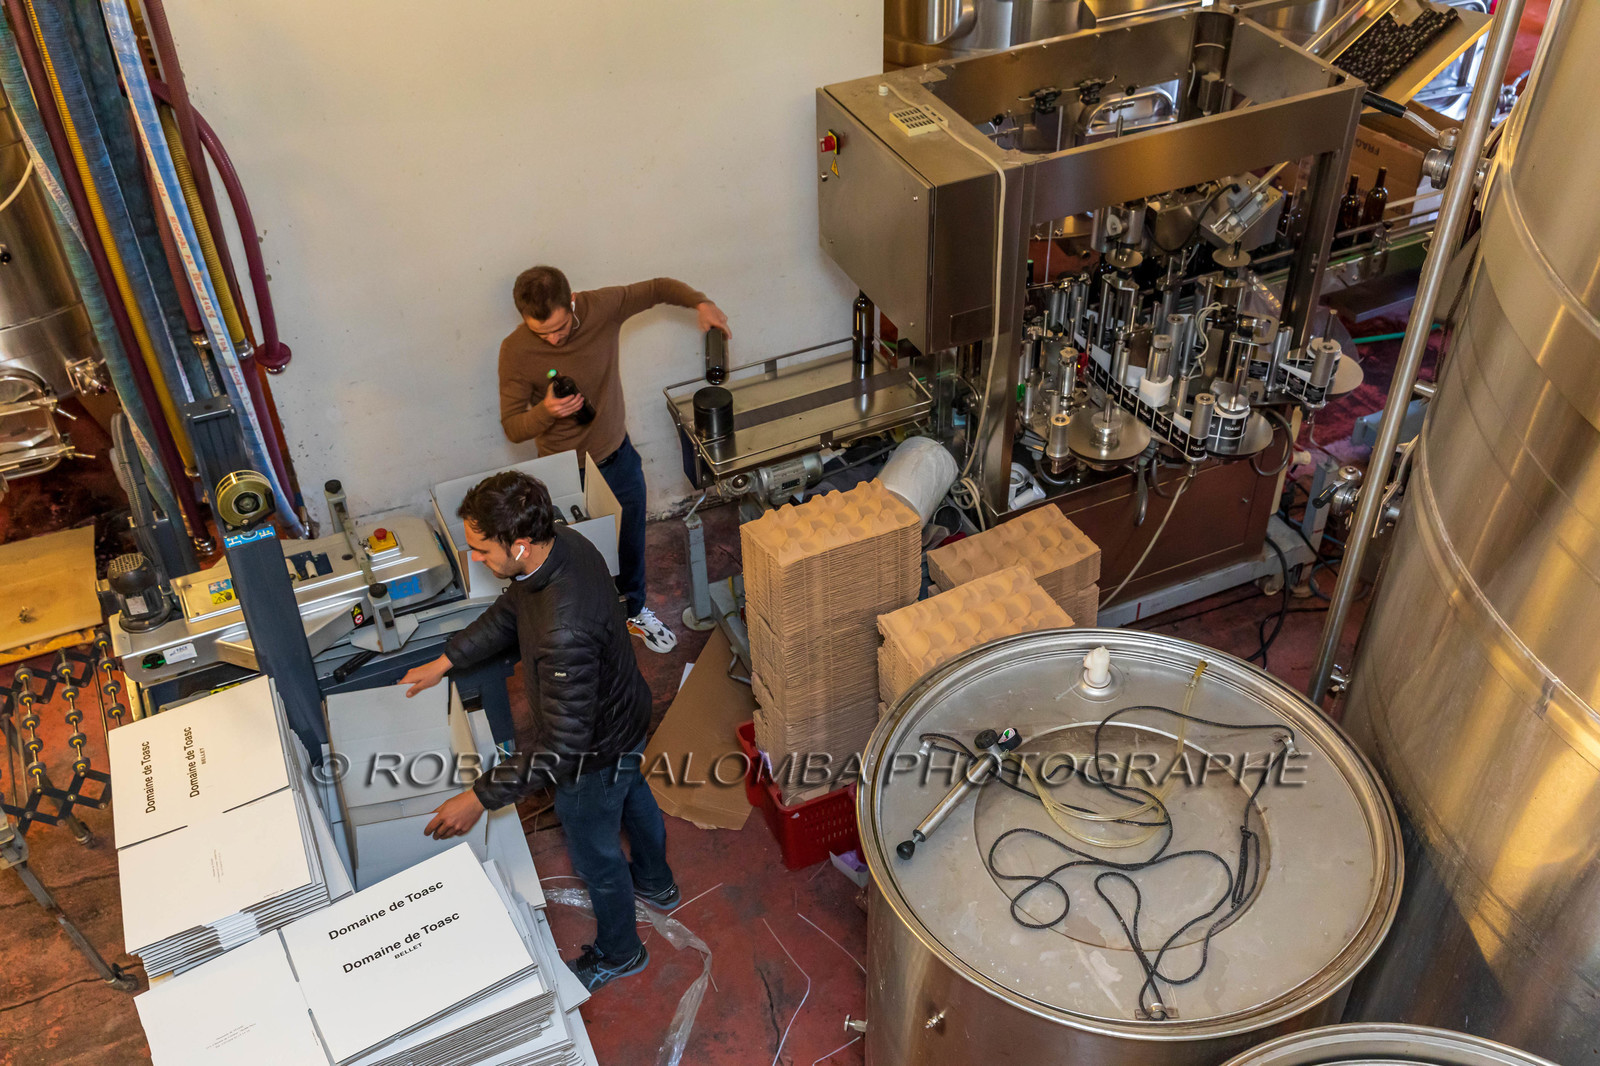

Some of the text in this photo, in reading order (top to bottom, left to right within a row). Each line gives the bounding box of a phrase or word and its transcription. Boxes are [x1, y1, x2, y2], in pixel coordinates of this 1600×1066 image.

[388, 576, 422, 600] iat
[141, 741, 156, 813] Domaine de Toasc
[184, 726, 200, 798] Domaine de Toasc
[328, 881, 444, 940] Domaine de Toasc
[342, 912, 460, 973] Domaine de Toasc
[394, 942, 423, 959] BELLET
